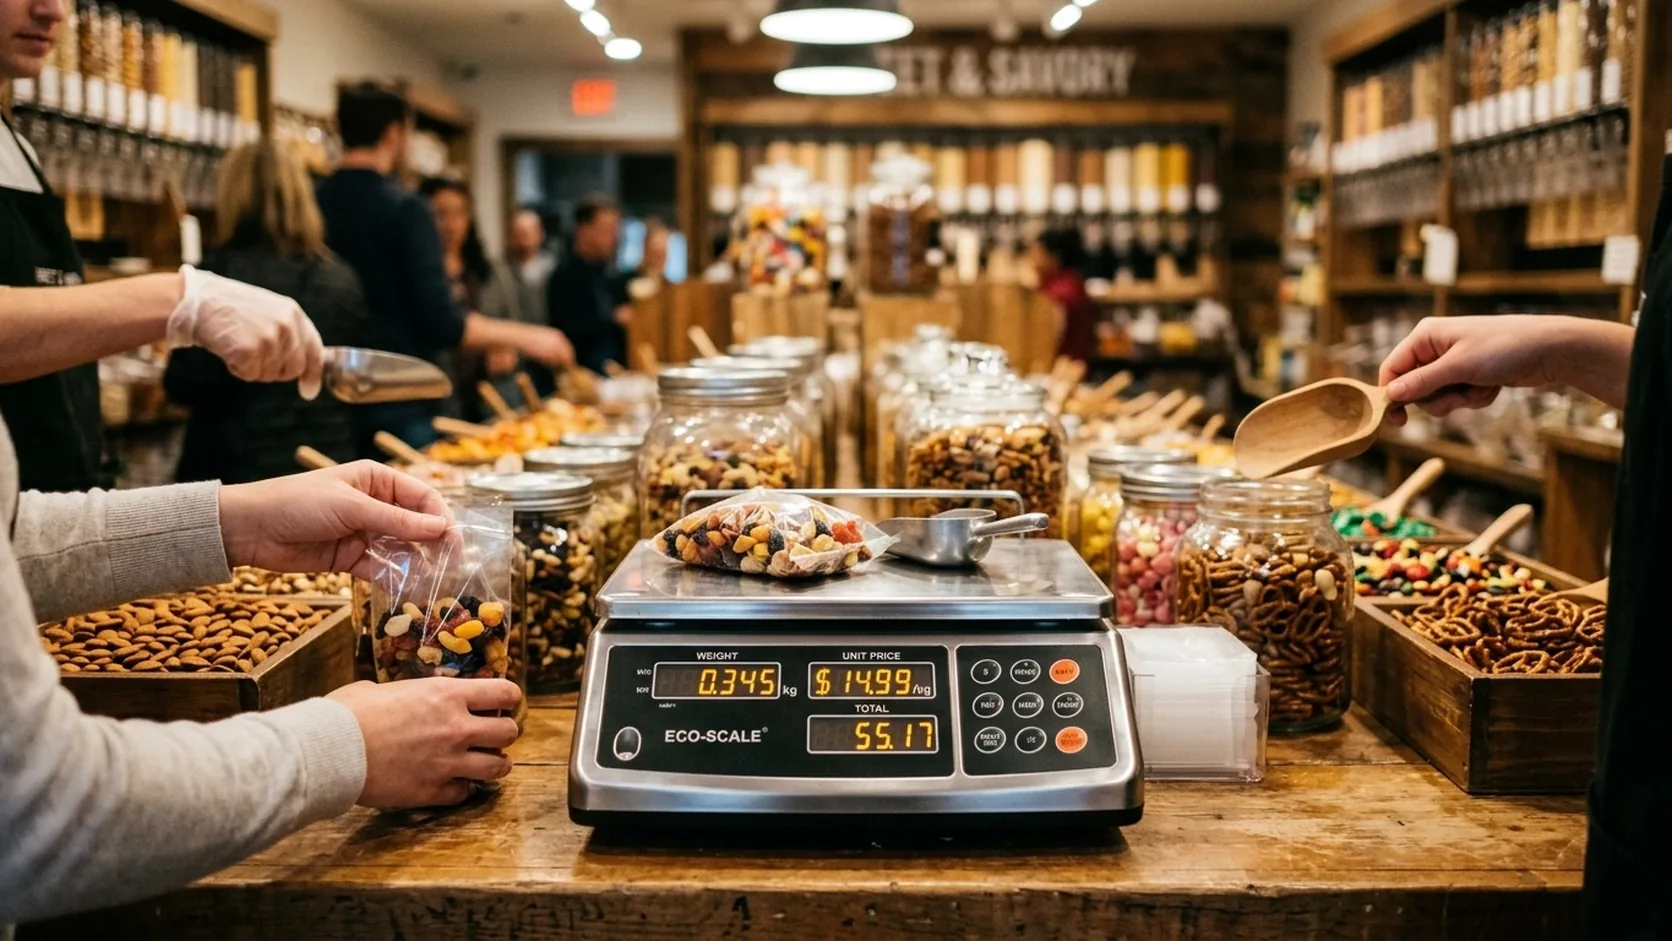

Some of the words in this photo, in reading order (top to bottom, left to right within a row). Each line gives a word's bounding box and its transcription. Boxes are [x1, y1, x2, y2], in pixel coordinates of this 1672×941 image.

[696, 652, 739, 660] WEIGHT
[842, 652, 867, 660] UNIT
[870, 652, 901, 660] PRICE
[698, 668, 775, 695] 0.345
[782, 684, 798, 697] kg
[855, 704, 889, 713] TOTAL
[855, 721, 933, 750] 55.17
